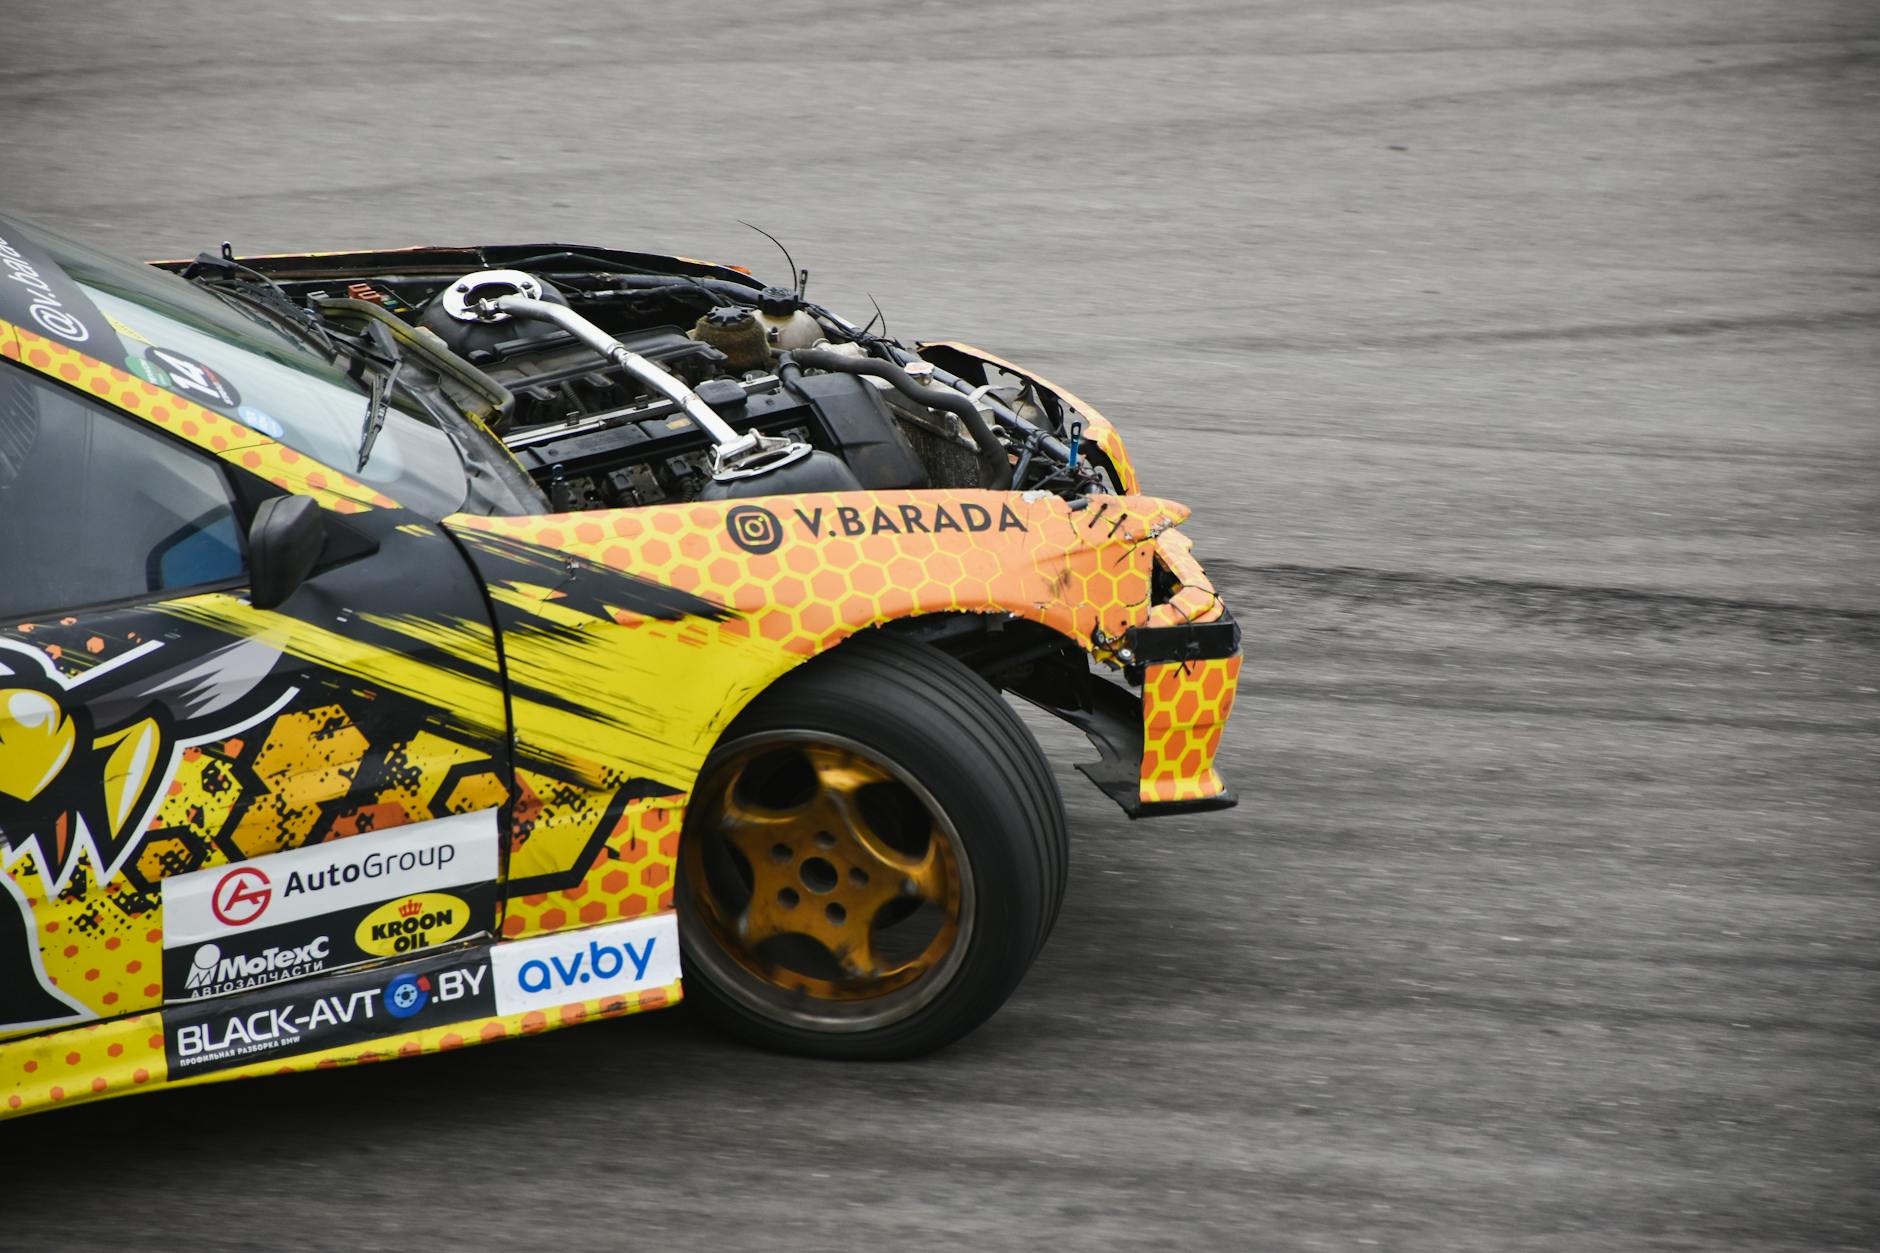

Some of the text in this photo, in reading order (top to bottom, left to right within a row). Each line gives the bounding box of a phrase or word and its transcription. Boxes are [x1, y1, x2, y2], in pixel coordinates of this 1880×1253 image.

[793, 502, 1028, 538] V.BARADA
[283, 844, 455, 897] AutoGroup
[371, 909, 452, 941] KROON
[393, 932, 429, 953] OIL
[191, 960, 324, 998] АВТОЗАПЧАСТИ
[518, 937, 656, 993] av.by
[179, 1049, 235, 1067] ПРОФИЛЬНАЯ
[237, 1040, 280, 1055] РАЗБОРКА
